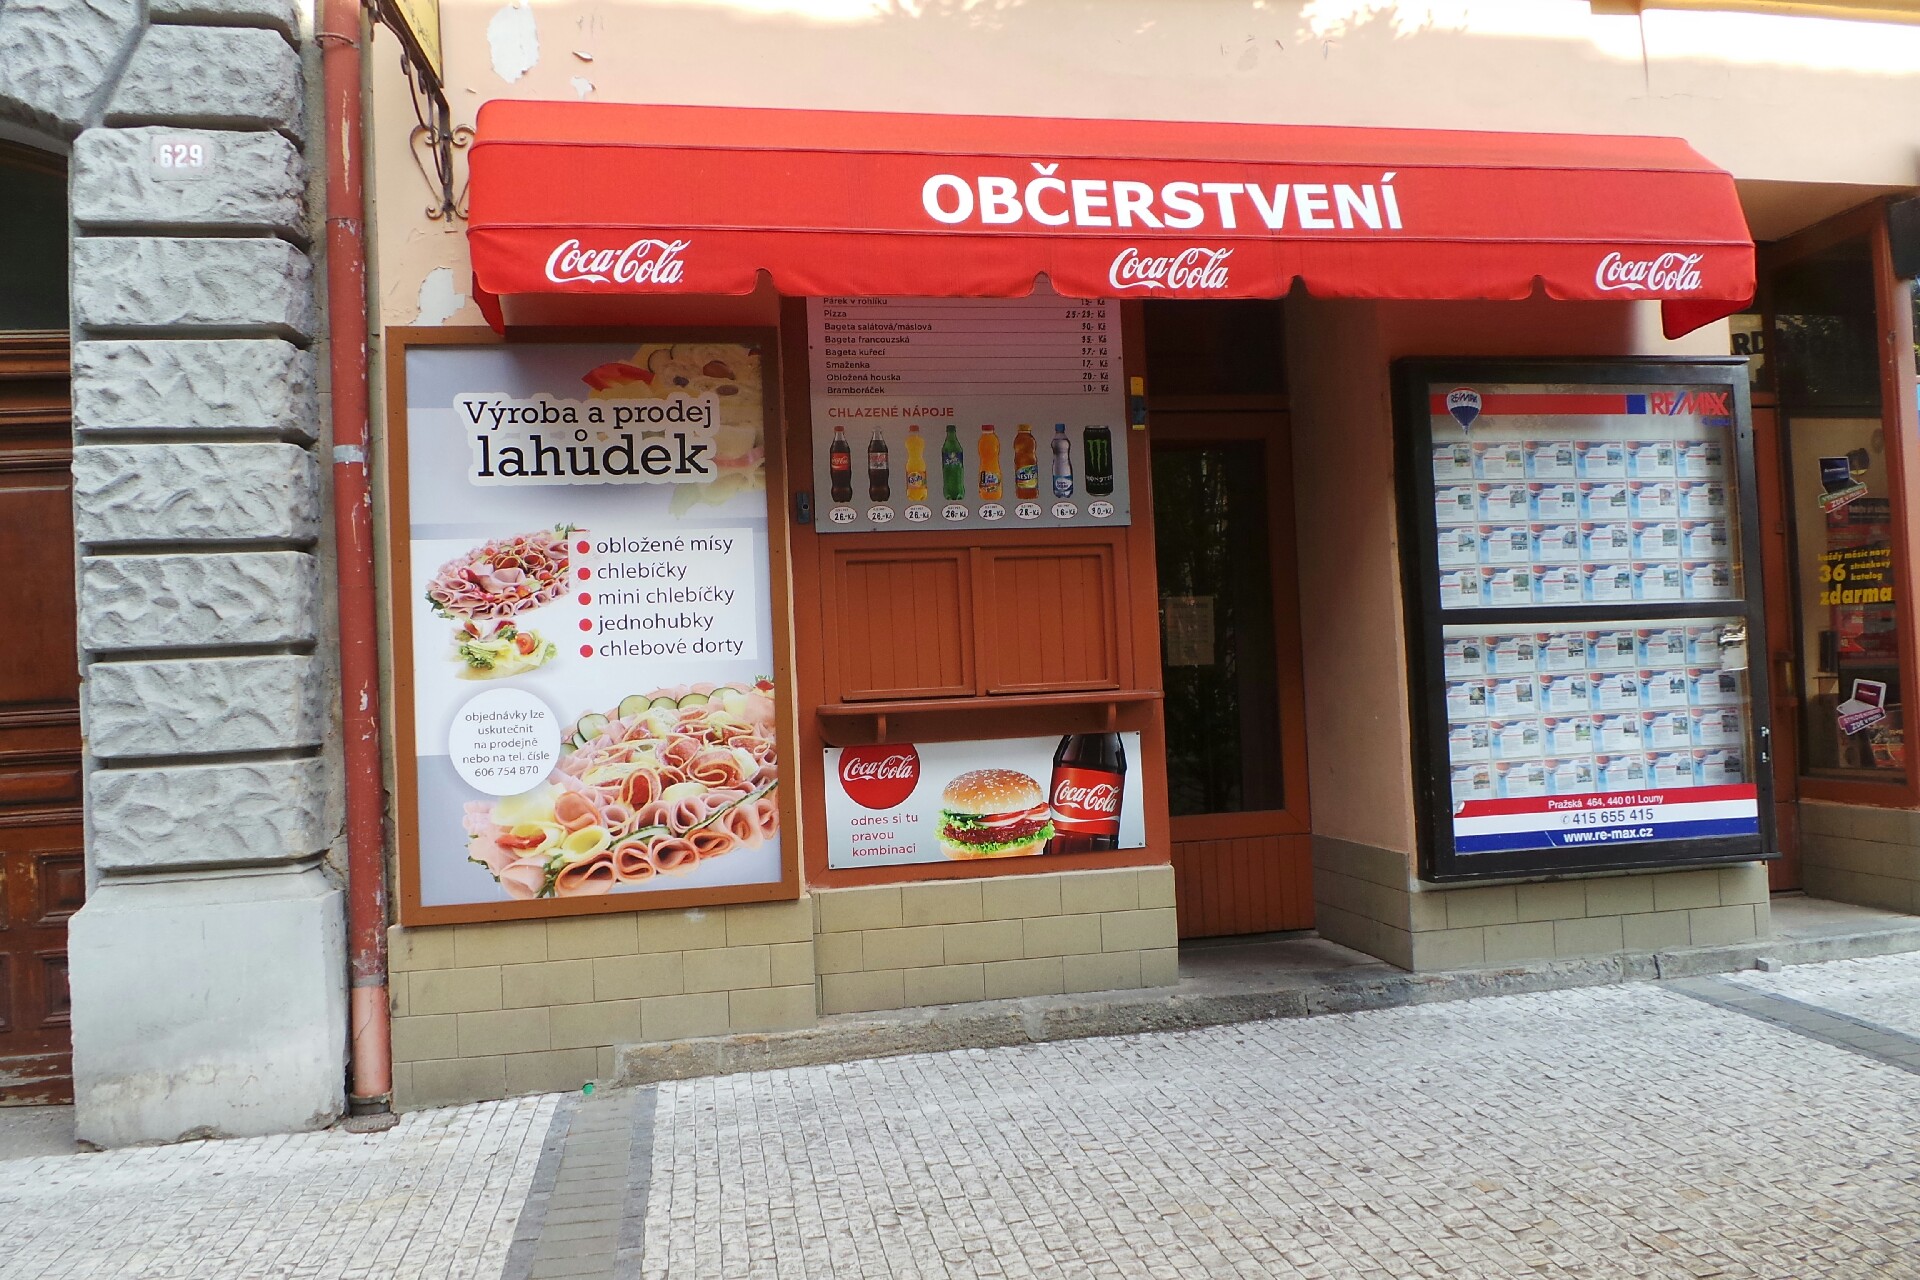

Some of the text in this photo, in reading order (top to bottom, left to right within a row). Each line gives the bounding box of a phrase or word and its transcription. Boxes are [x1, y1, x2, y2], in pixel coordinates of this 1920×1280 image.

[160, 144, 203, 168] 629
[921, 163, 1403, 229] OBČERSTVENÍ
[545, 238, 691, 283] Coca-Cola
[1109, 247, 1234, 289] Coca-Cola
[1596, 251, 1705, 291] Coca-Cola
[823, 309, 847, 318] Pizza
[824, 322, 932, 332] Bageta salátová/máslová
[824, 335, 910, 345] Bageta francouzská
[825, 348, 886, 357] Bageta kuřecí
[826, 360, 870, 369] Smaženka
[826, 373, 901, 381] Obložená houska
[827, 386, 885, 394] Bramboráček
[1652, 391, 1730, 416] RE/MAX
[463, 400, 712, 430] Výroba a prodej
[828, 405, 954, 418] CHLAZENÉ NÁPOJE
[477, 429, 709, 476] lahůdek
[596, 535, 733, 554] obložené mísy
[1869, 547, 1891, 557] nový
[597, 561, 687, 581] chlebíčky
[1850, 559, 1890, 570] stránkový
[1818, 563, 1846, 583] 36
[1851, 571, 1883, 582] katalog
[598, 585, 735, 605] mini chlebíčky
[1820, 584, 1892, 606] zdarma
[597, 612, 714, 635] jednohubky
[600, 637, 744, 657] chlebové dorty
[465, 709, 545, 723] objednávky lze
[477, 724, 533, 735] uskutečnit
[489, 738, 538, 750] prodejně
[462, 754, 490, 764] nebo
[508, 752, 525, 762] tel.
[527, 751, 550, 761] čísle
[474, 765, 539, 777] 606 754 870
[843, 754, 916, 781] Coca-Cola
[1054, 779, 1121, 813] Coca-Cola
[1548, 799, 1582, 809] Pražská
[1607, 796, 1623, 806] 440
[1625, 795, 1636, 805] 01
[1637, 794, 1664, 804] Louny
[851, 813, 918, 826] odnes si tu
[1572, 808, 1654, 825] 415 655 415
[851, 830, 894, 843] pravou
[1563, 827, 1653, 843] www.re-max.cz
[852, 843, 916, 857] kombinaci
